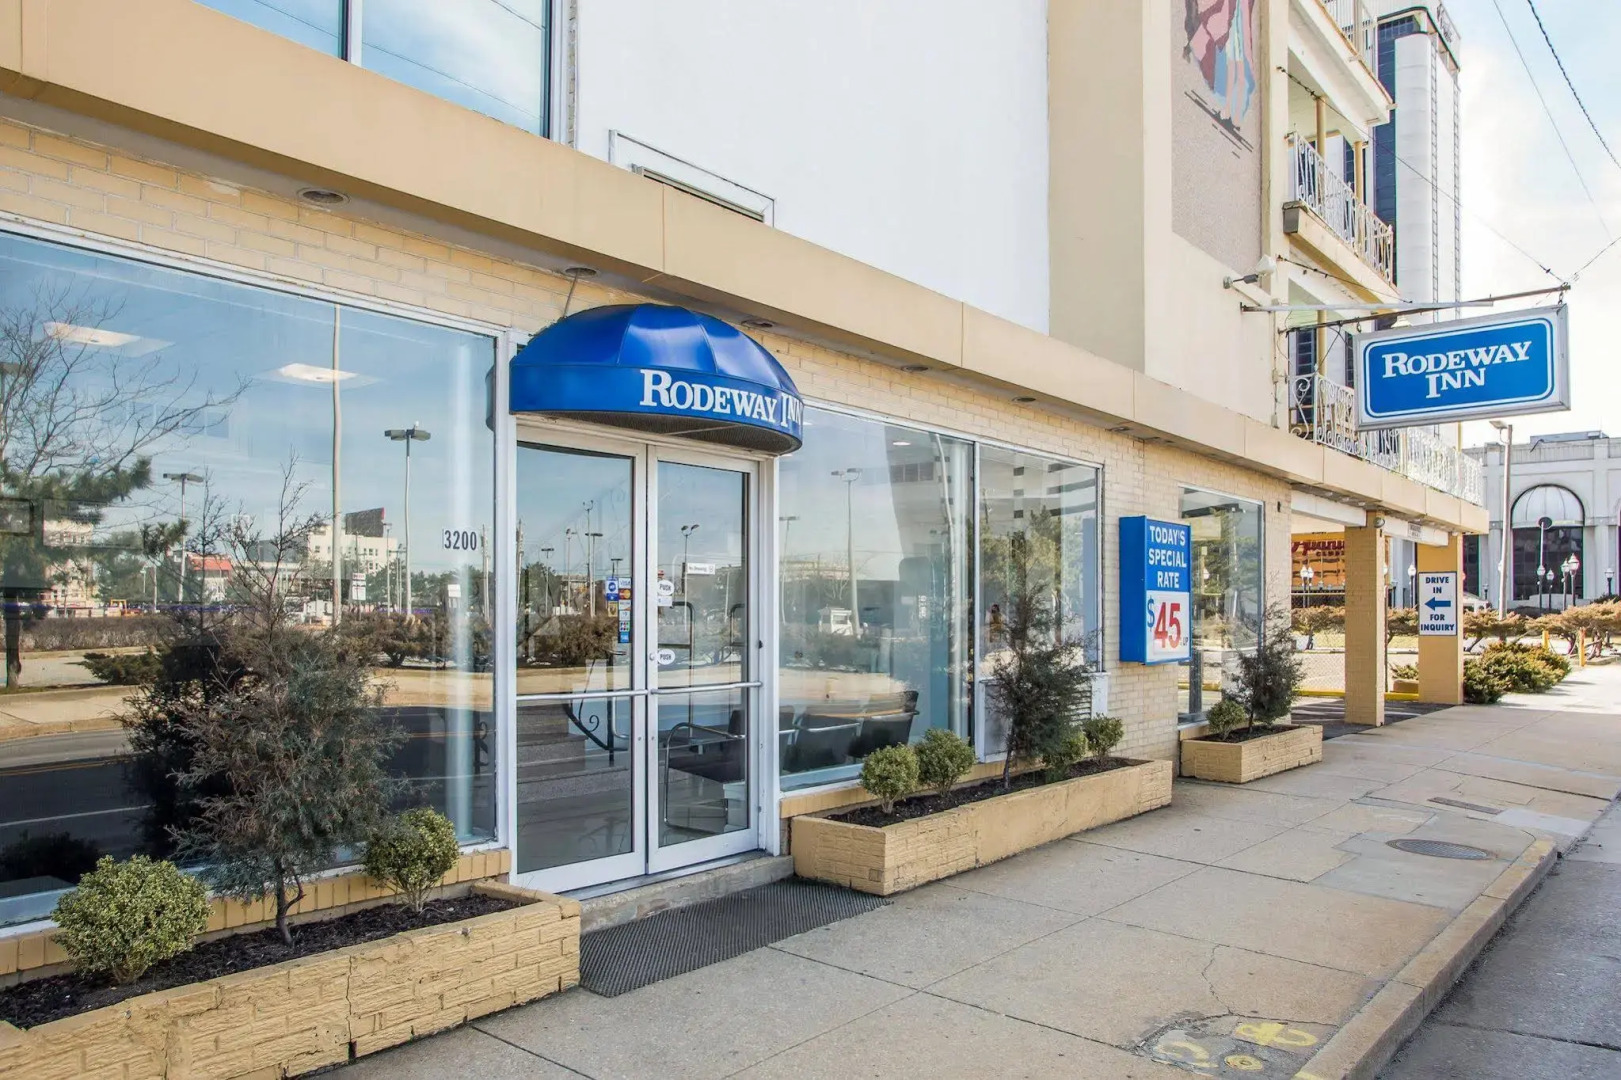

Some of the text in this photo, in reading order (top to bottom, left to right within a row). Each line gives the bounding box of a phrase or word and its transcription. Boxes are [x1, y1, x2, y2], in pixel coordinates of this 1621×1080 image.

[1382, 341, 1532, 378] RODEWAY
[1426, 368, 1485, 398] INN
[640, 369, 777, 423] RODEWAY
[443, 530, 477, 551] 3200
[1149, 526, 1186, 546] TODAY'S
[1148, 549, 1187, 568] SPECIAL
[1157, 571, 1180, 588] RATE
[1425, 576, 1449, 584] DRIVE
[1421, 624, 1454, 632] INQUIRY
